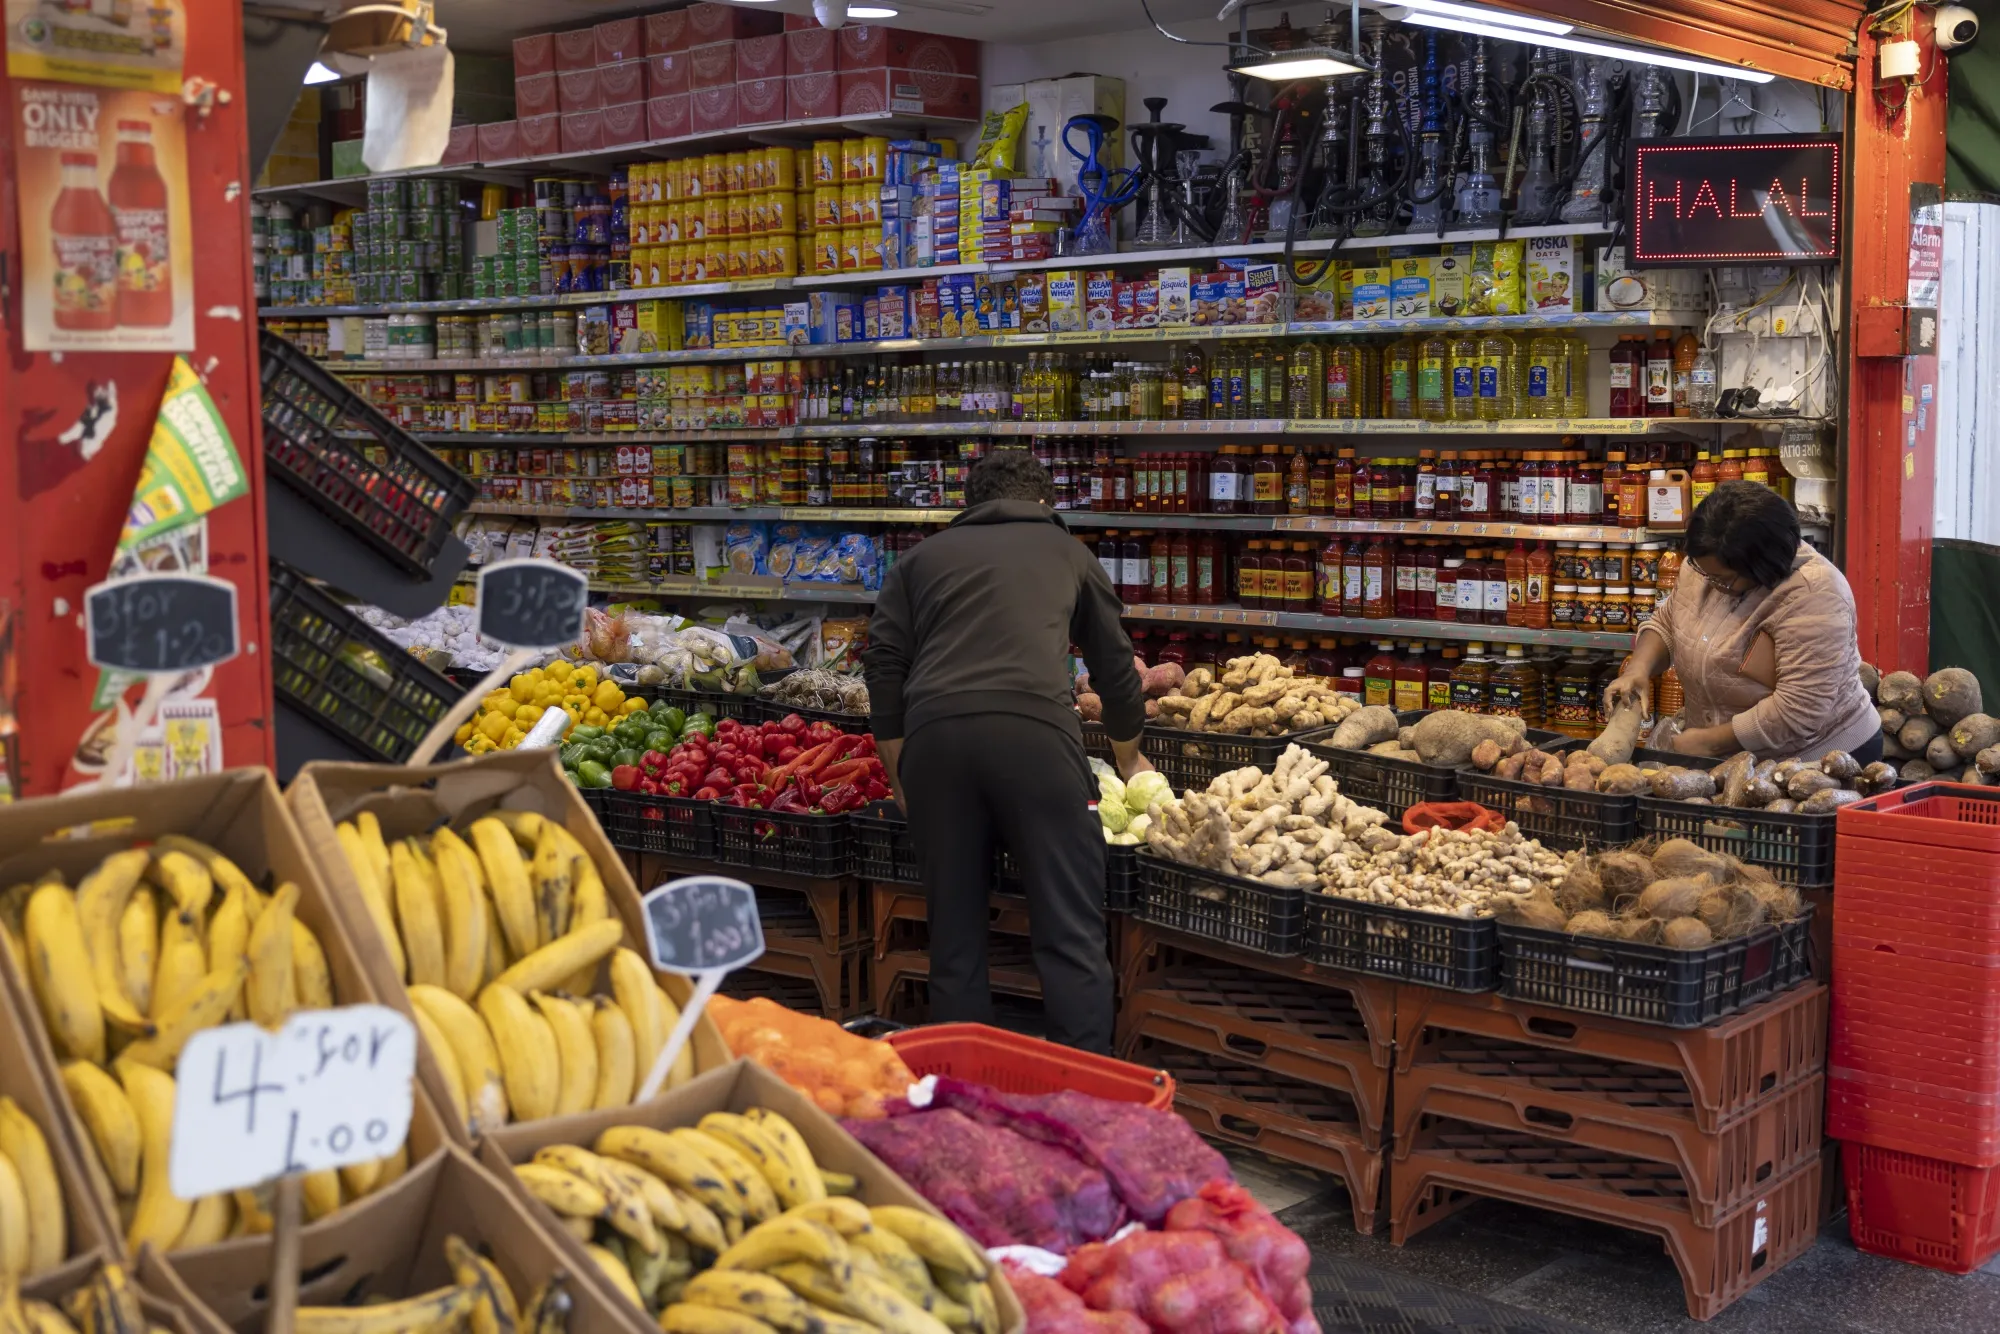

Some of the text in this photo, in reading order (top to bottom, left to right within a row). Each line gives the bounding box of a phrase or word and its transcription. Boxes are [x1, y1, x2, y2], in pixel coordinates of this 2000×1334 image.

[1459, 60, 1470, 90] SHISHA
[1408, 66, 1420, 97] SHISHA
[23, 103, 98, 130] ONLY
[1648, 178, 1828, 220] HALAL
[1530, 235, 1569, 250] FOSKA
[1911, 232, 1940, 247] Alarm
[1248, 269, 1273, 282] SHAKE
[1254, 275, 1274, 287] BAKE
[1050, 281, 1076, 289] CREAM
[1088, 280, 1112, 289] CREAM
[1160, 280, 1188, 291] Bisquick
[1020, 288, 1042, 297] CREAM
[1050, 289, 1076, 297] WHEAT
[1088, 289, 1112, 298] WHEAT
[1021, 296, 1042, 304] WHEAT
[616, 310, 634, 319] Swans
[181, 390, 239, 486] CUPBOARD
[1801, 443, 1822, 458] PURE
